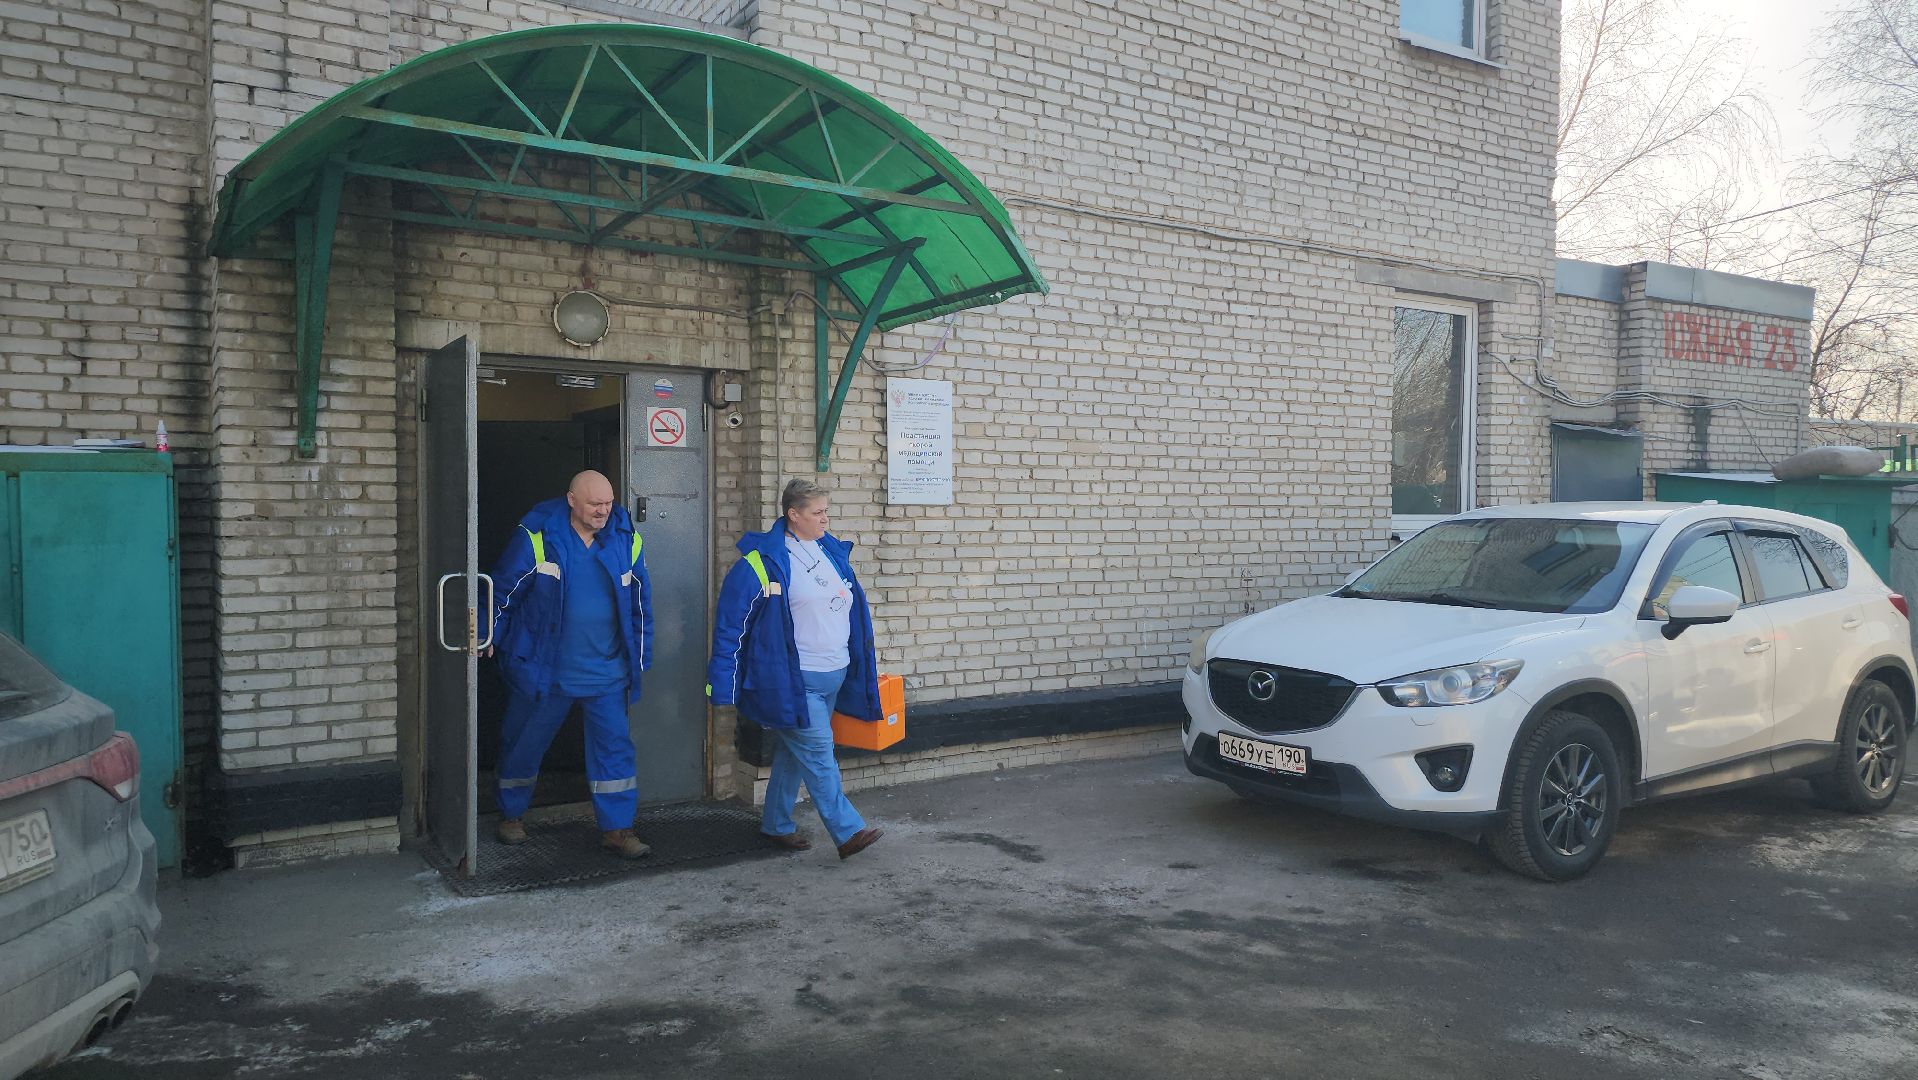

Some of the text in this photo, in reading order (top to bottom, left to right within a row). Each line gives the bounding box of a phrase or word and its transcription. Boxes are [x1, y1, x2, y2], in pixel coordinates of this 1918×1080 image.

[1664, 311, 1798, 372] ЮЖНАЯ 23
[900, 432, 941, 440] Подстанция
[1277, 747, 1301, 764] 190
[17, 850, 37, 866] RUS
